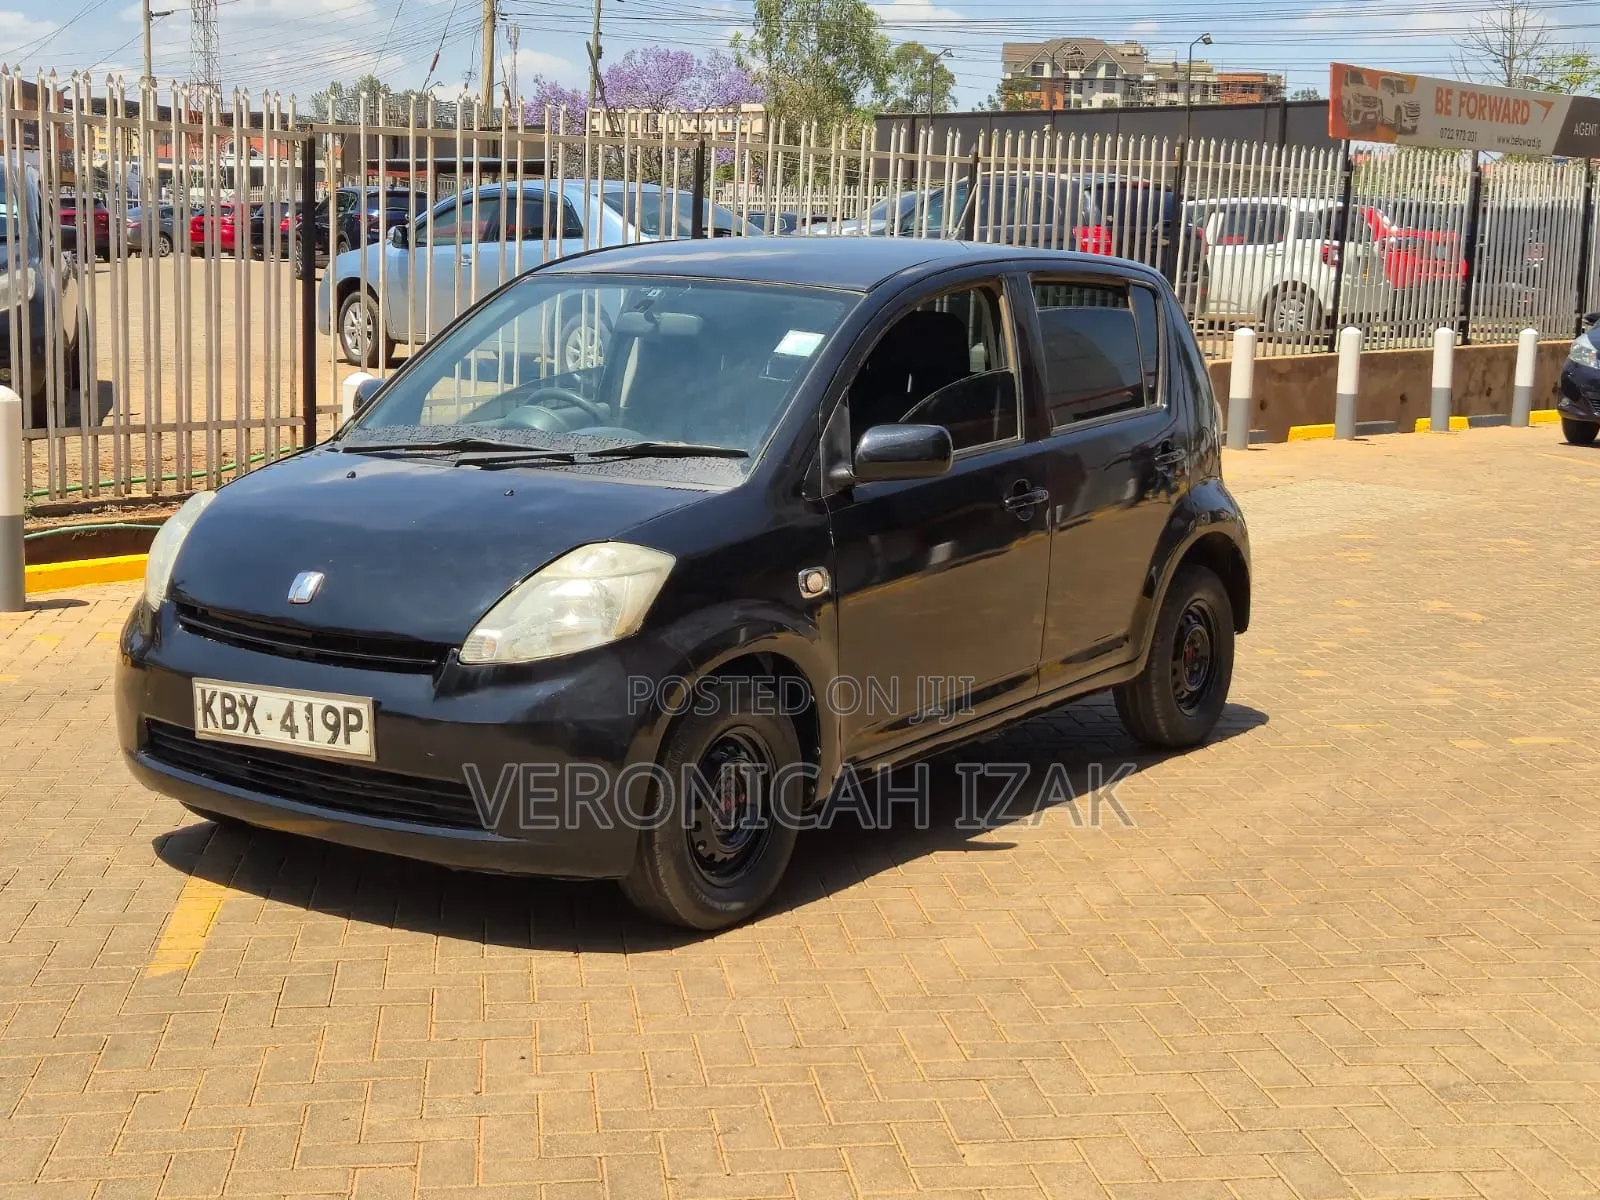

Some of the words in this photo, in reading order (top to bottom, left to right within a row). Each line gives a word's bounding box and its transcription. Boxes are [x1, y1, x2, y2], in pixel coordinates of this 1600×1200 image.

[1434, 86, 1453, 116] BE
[1458, 90, 1530, 126] FORWARD
[1573, 122, 1598, 136] AGENT
